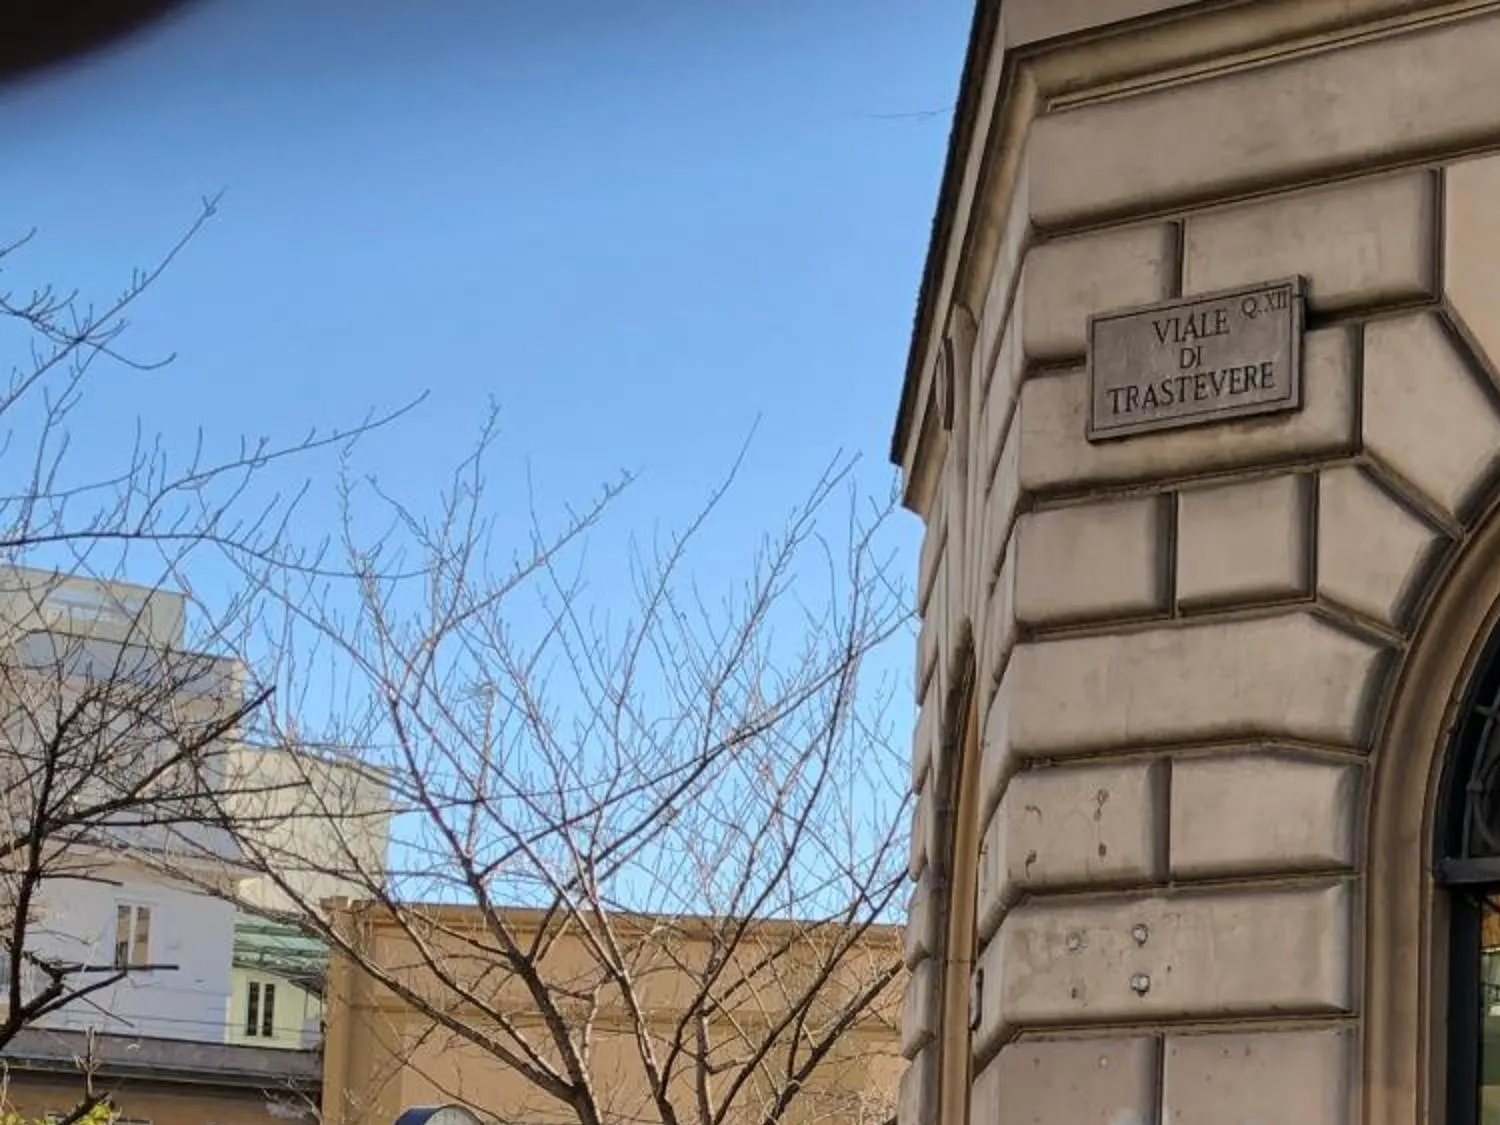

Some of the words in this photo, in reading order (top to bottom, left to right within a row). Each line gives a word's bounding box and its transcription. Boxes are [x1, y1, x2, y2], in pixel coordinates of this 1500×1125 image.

[1153, 308, 1231, 345] VIALE
[1179, 346, 1203, 370] DI
[1106, 361, 1275, 415] TRASTEVERE
